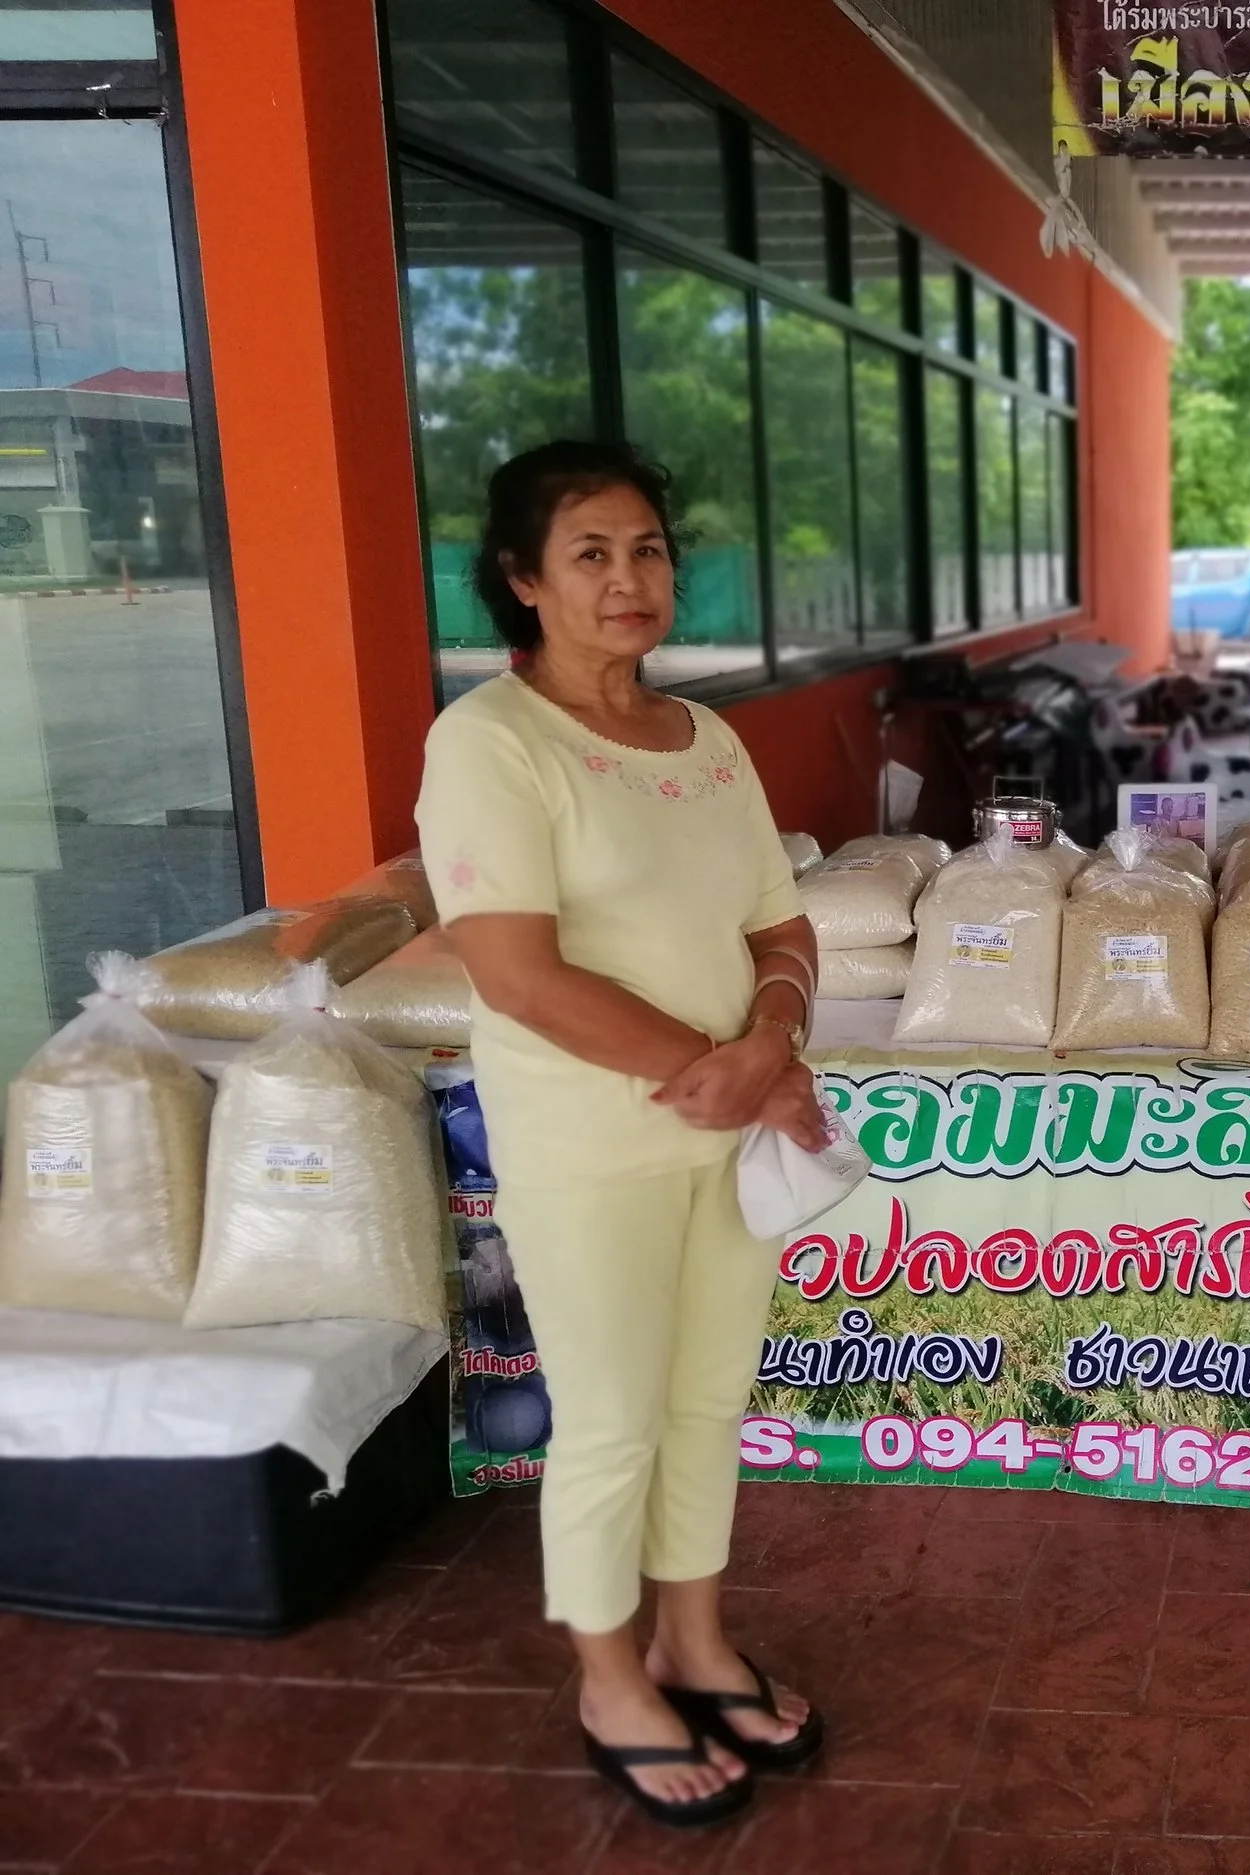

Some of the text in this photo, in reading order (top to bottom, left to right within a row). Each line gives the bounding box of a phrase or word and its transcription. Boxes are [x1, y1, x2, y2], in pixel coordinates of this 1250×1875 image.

[1014, 824, 1040, 832] ZEBRA
[758, 1308, 1001, 1386] นาทำเอง
